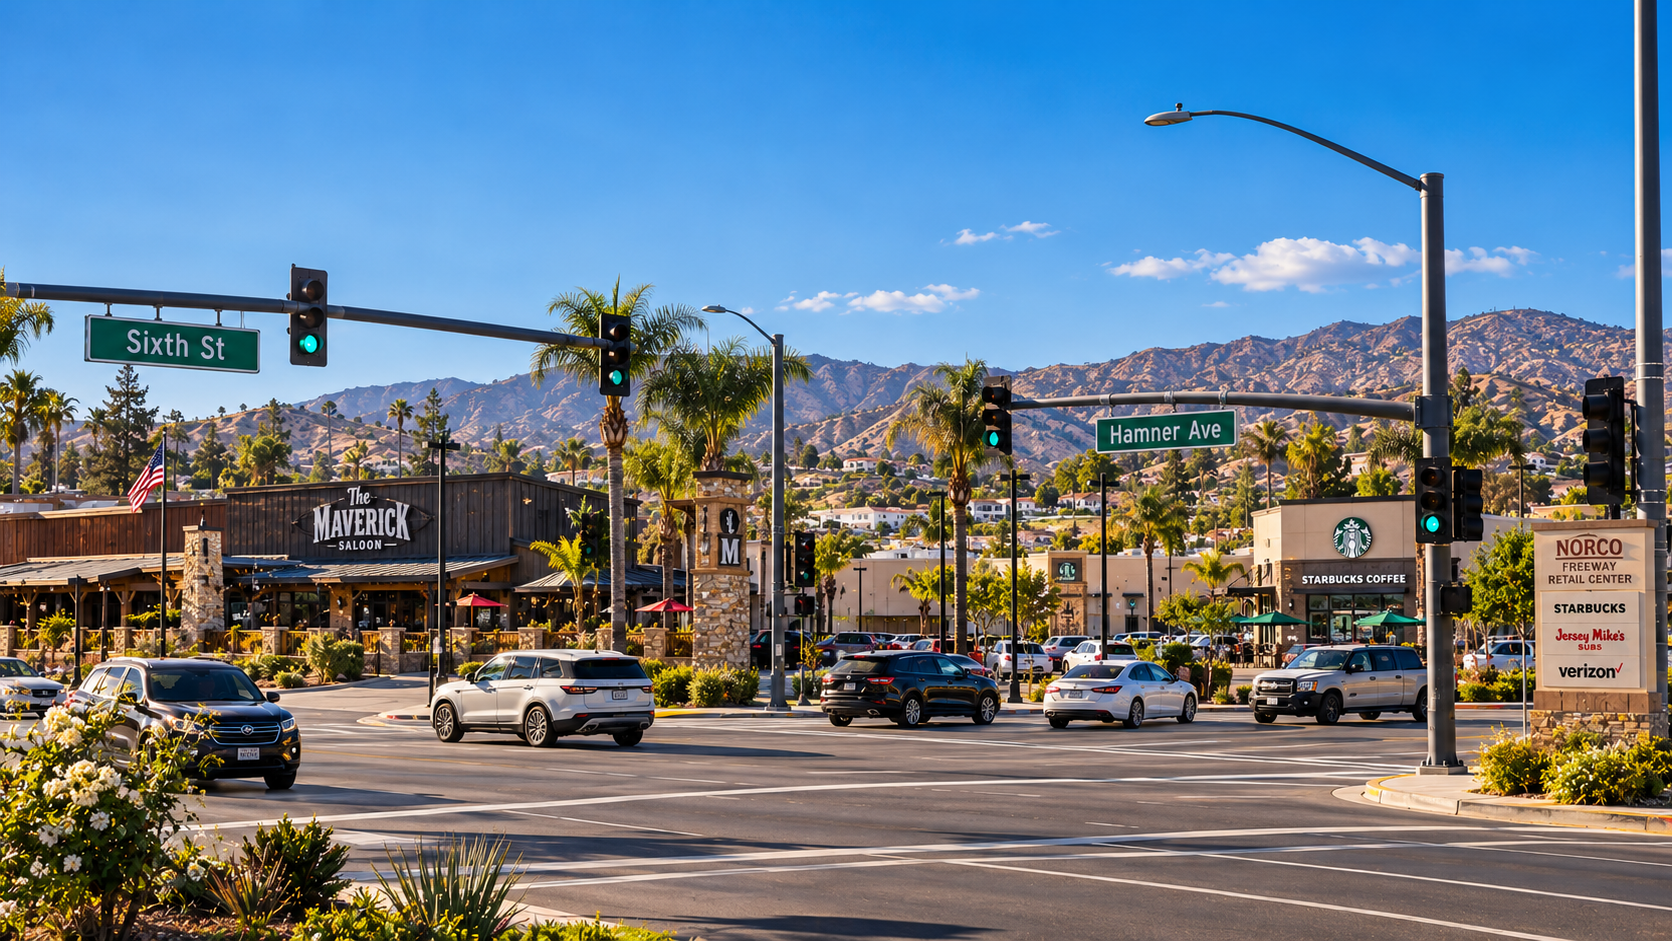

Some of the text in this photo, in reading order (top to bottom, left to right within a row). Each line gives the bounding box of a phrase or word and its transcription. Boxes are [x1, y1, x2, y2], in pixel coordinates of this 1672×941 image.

[126, 328, 225, 360] Sixth St
[1110, 420, 1221, 444] Hamner Ave
[347, 485, 371, 506] The
[313, 501, 411, 543] MAVERICK
[338, 540, 382, 551] SALOON
[720, 538, 740, 565] M
[1556, 538, 1623, 556] NORCO
[1562, 561, 1617, 572] FREEWAY
[1302, 574, 1406, 585] STARBUCKS COFFEE
[1548, 574, 1632, 584] RETAIL CENTER
[1554, 603, 1626, 614] STARBUCKS
[1555, 628, 1625, 643] Jersey Mike's
[1559, 663, 1616, 679] verizon
